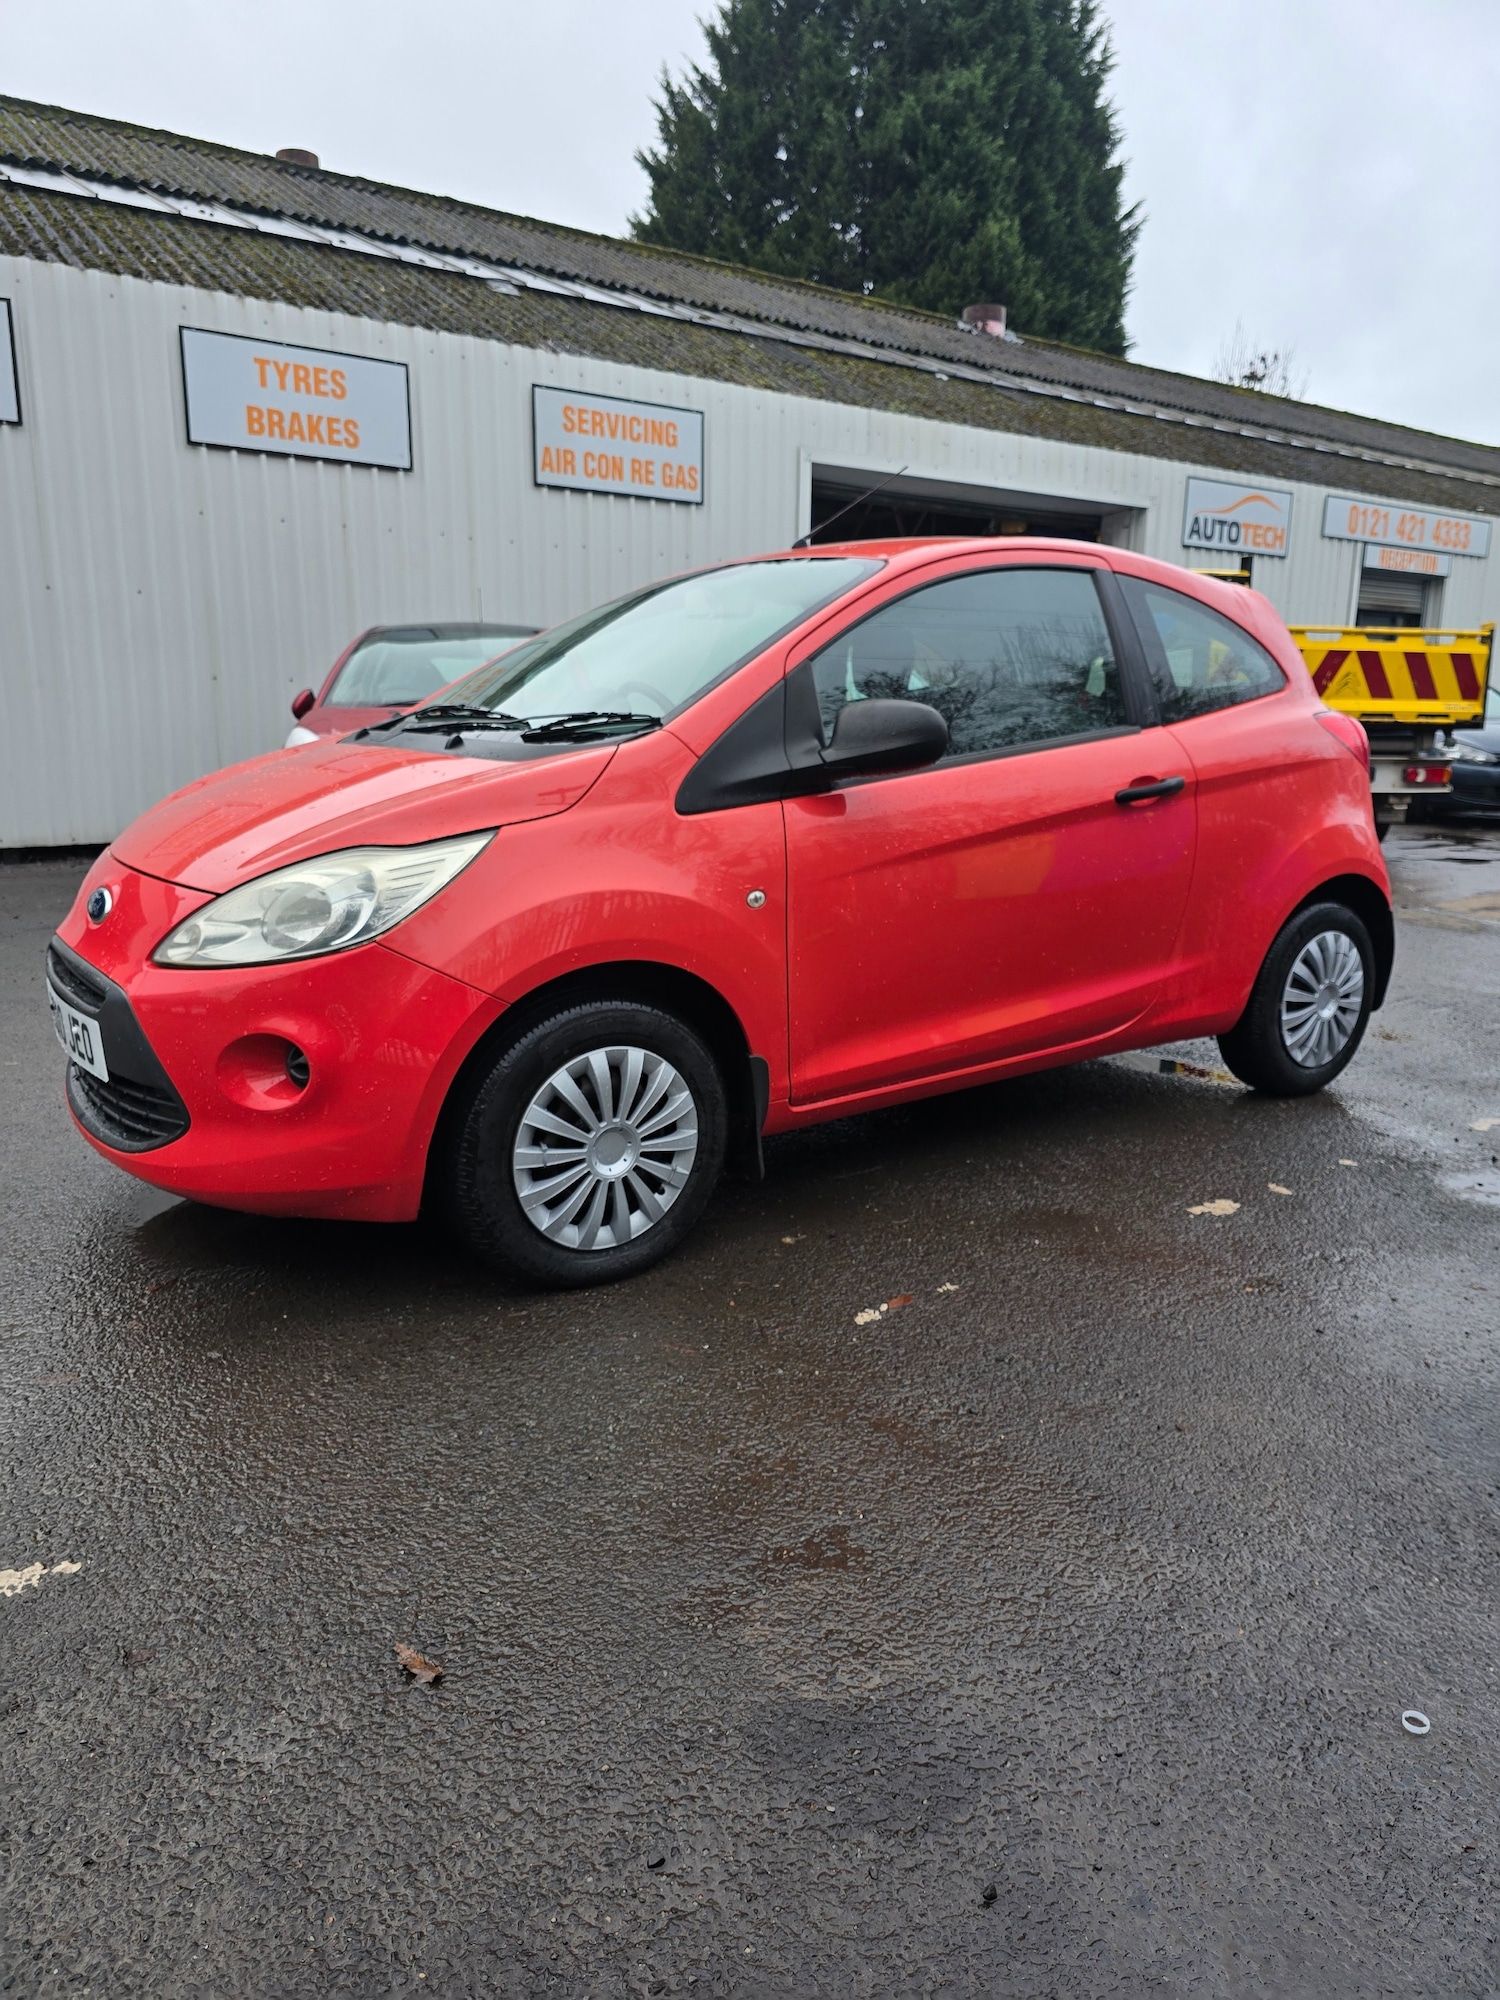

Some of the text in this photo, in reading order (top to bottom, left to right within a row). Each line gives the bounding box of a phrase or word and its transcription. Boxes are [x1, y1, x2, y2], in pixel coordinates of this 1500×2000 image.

[253, 356, 348, 401] TYRES
[246, 405, 361, 449] BRAKES
[562, 404, 679, 449] SERVICING
[541, 446, 698, 491] AIR CON RE GAS
[1189, 516, 1286, 550] AUTOTECH
[1347, 505, 1471, 550] 0121 421 4333
[1379, 547, 1439, 573] RECEPTION
